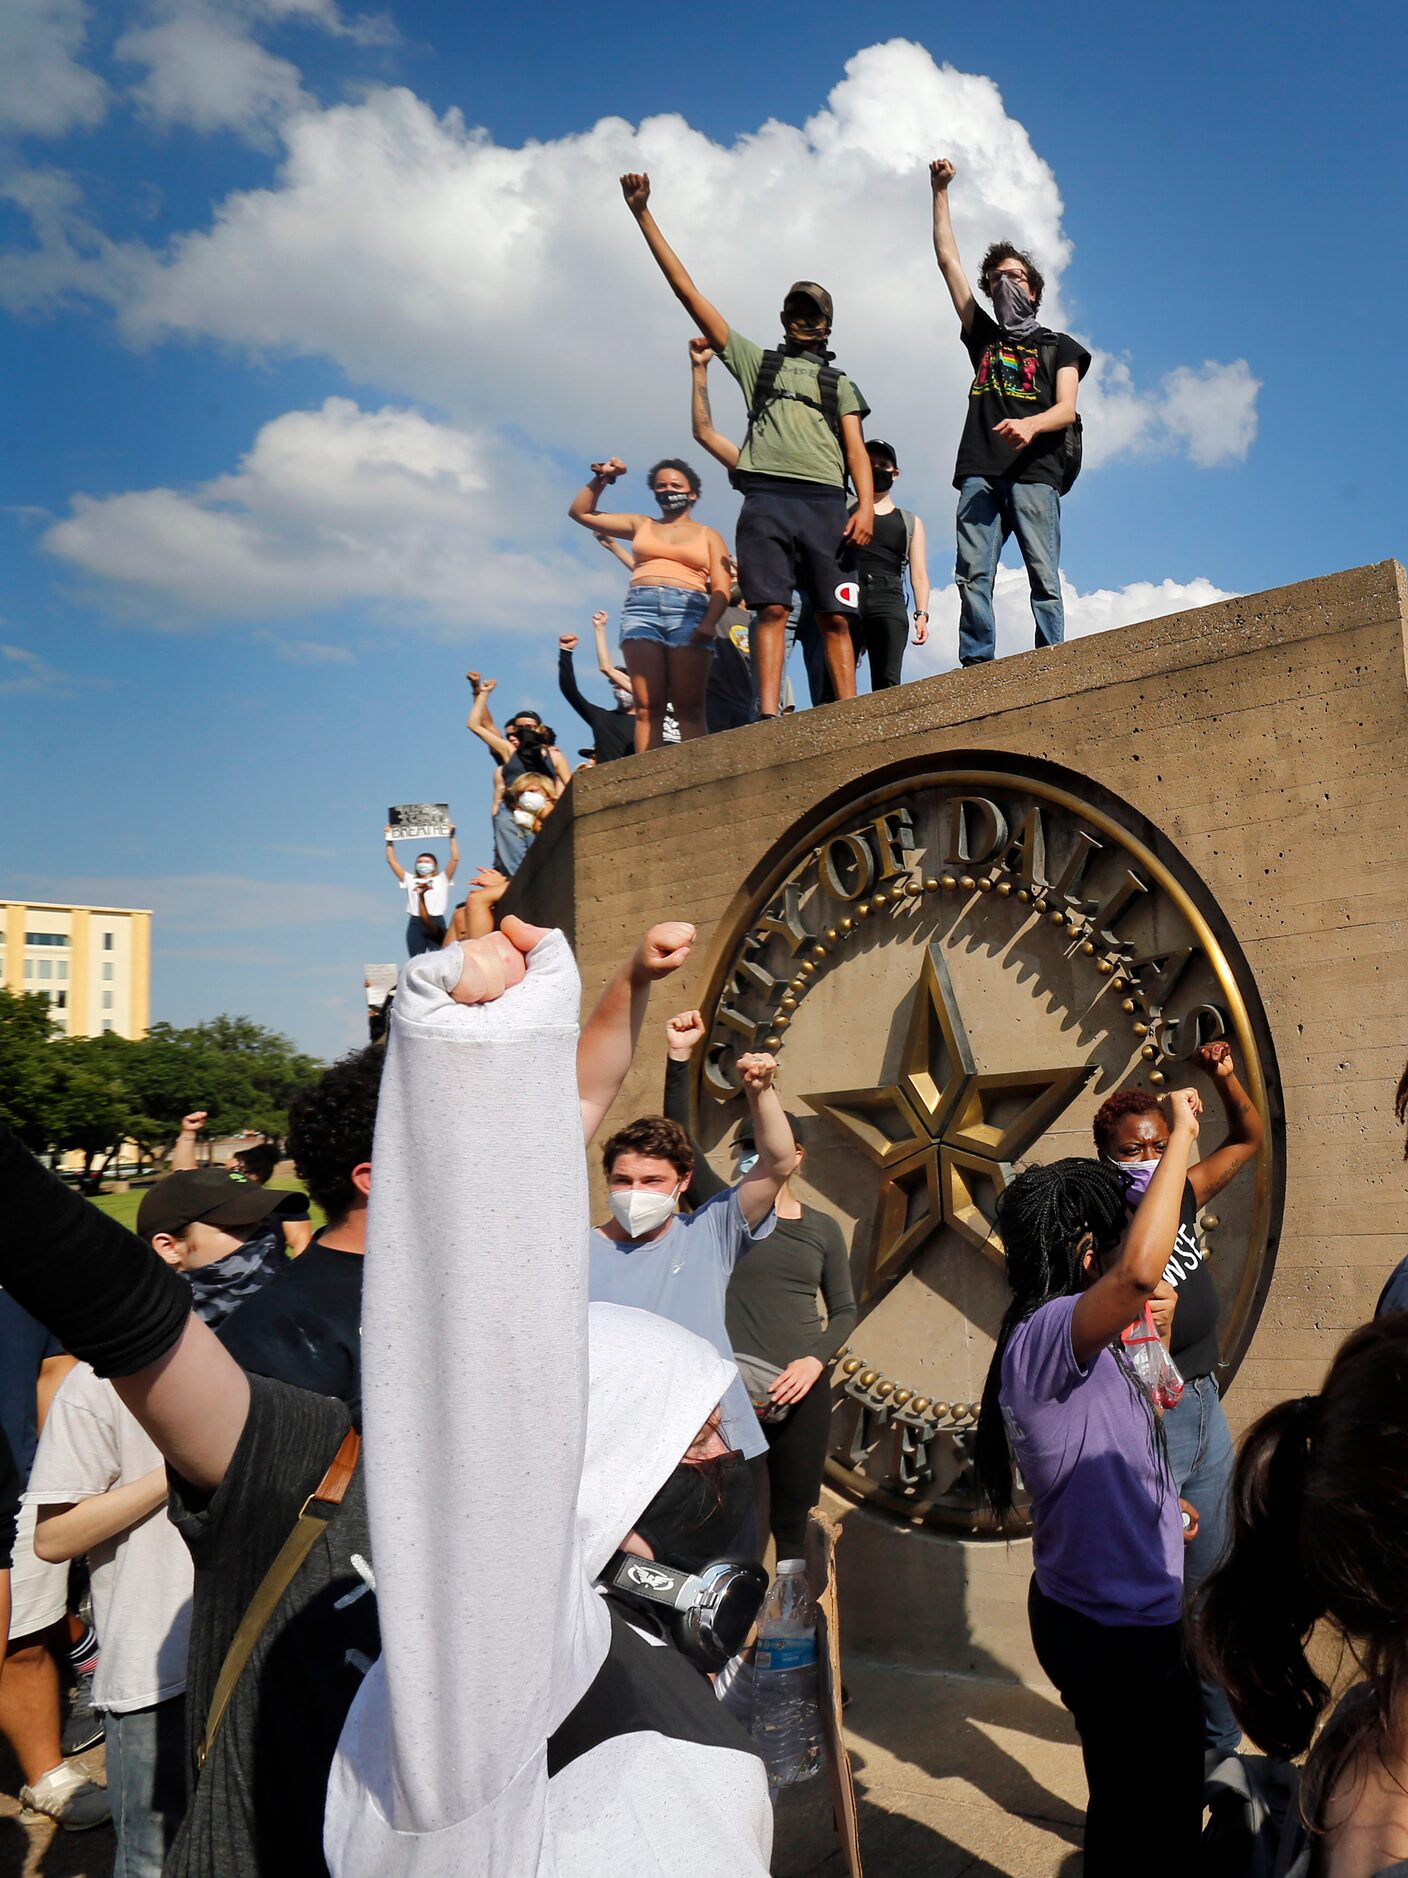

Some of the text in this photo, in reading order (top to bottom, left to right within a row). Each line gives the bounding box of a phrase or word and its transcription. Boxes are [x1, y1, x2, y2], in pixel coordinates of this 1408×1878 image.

[704, 796, 1225, 1100] CITY OF DALLAS
